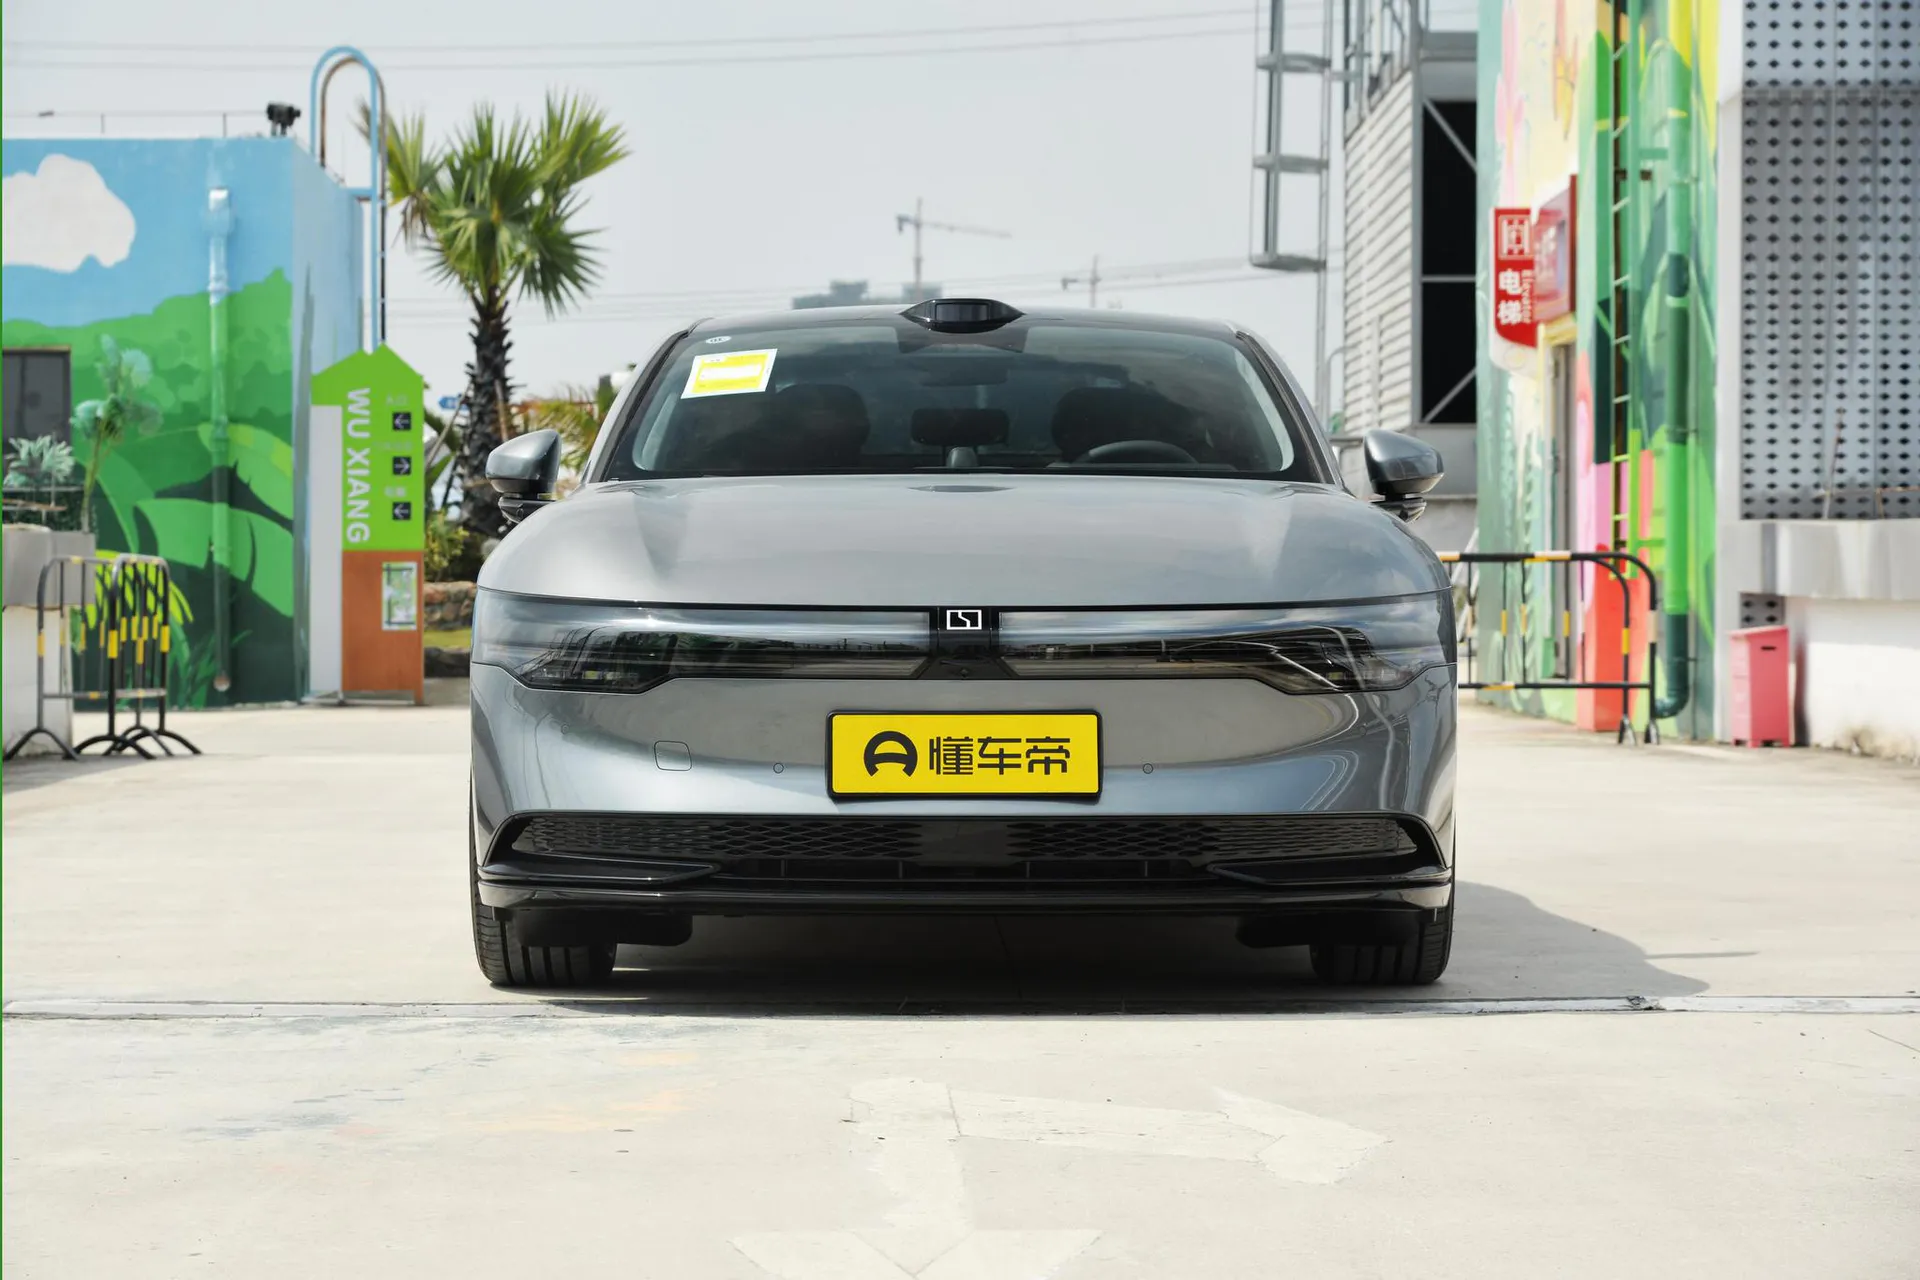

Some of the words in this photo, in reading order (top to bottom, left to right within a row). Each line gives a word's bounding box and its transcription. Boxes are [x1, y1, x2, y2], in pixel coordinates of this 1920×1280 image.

[1498, 268, 1522, 325] 电梯
[346, 387, 371, 439] WU
[346, 447, 371, 543] XIANG
[928, 736, 1071, 776] 懂车帝
